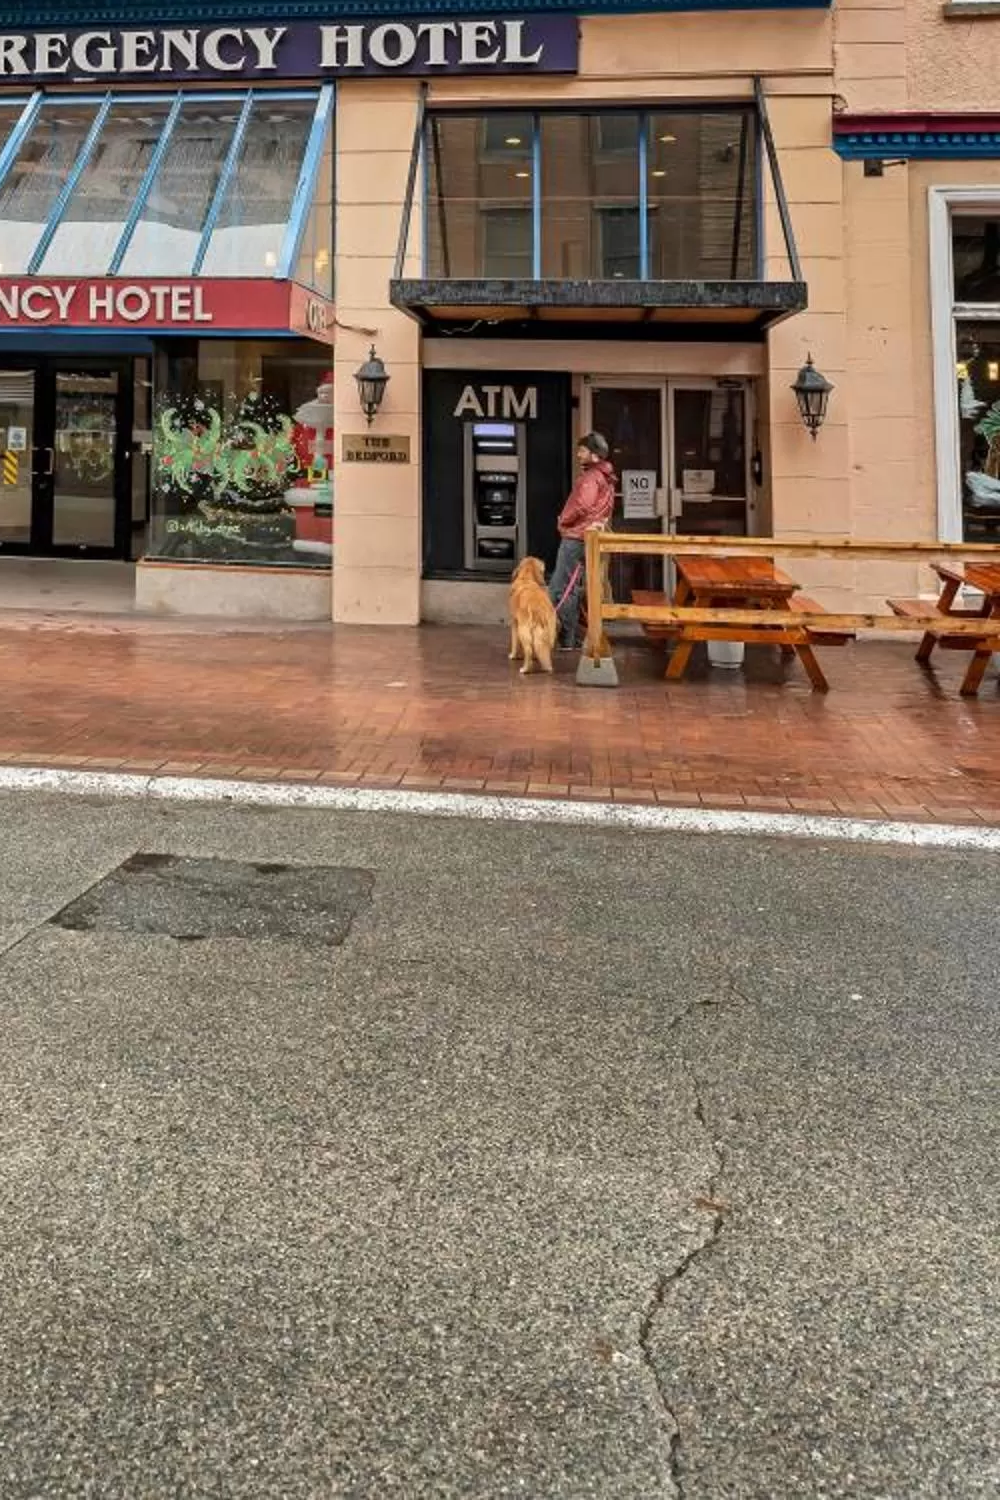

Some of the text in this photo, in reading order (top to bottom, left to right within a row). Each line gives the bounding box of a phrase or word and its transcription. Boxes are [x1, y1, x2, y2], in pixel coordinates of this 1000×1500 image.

[319, 20, 544, 67] HOTEL
[88, 285, 213, 321] HOTEL
[453, 385, 537, 419] ATM
[630, 477, 650, 489] NO
